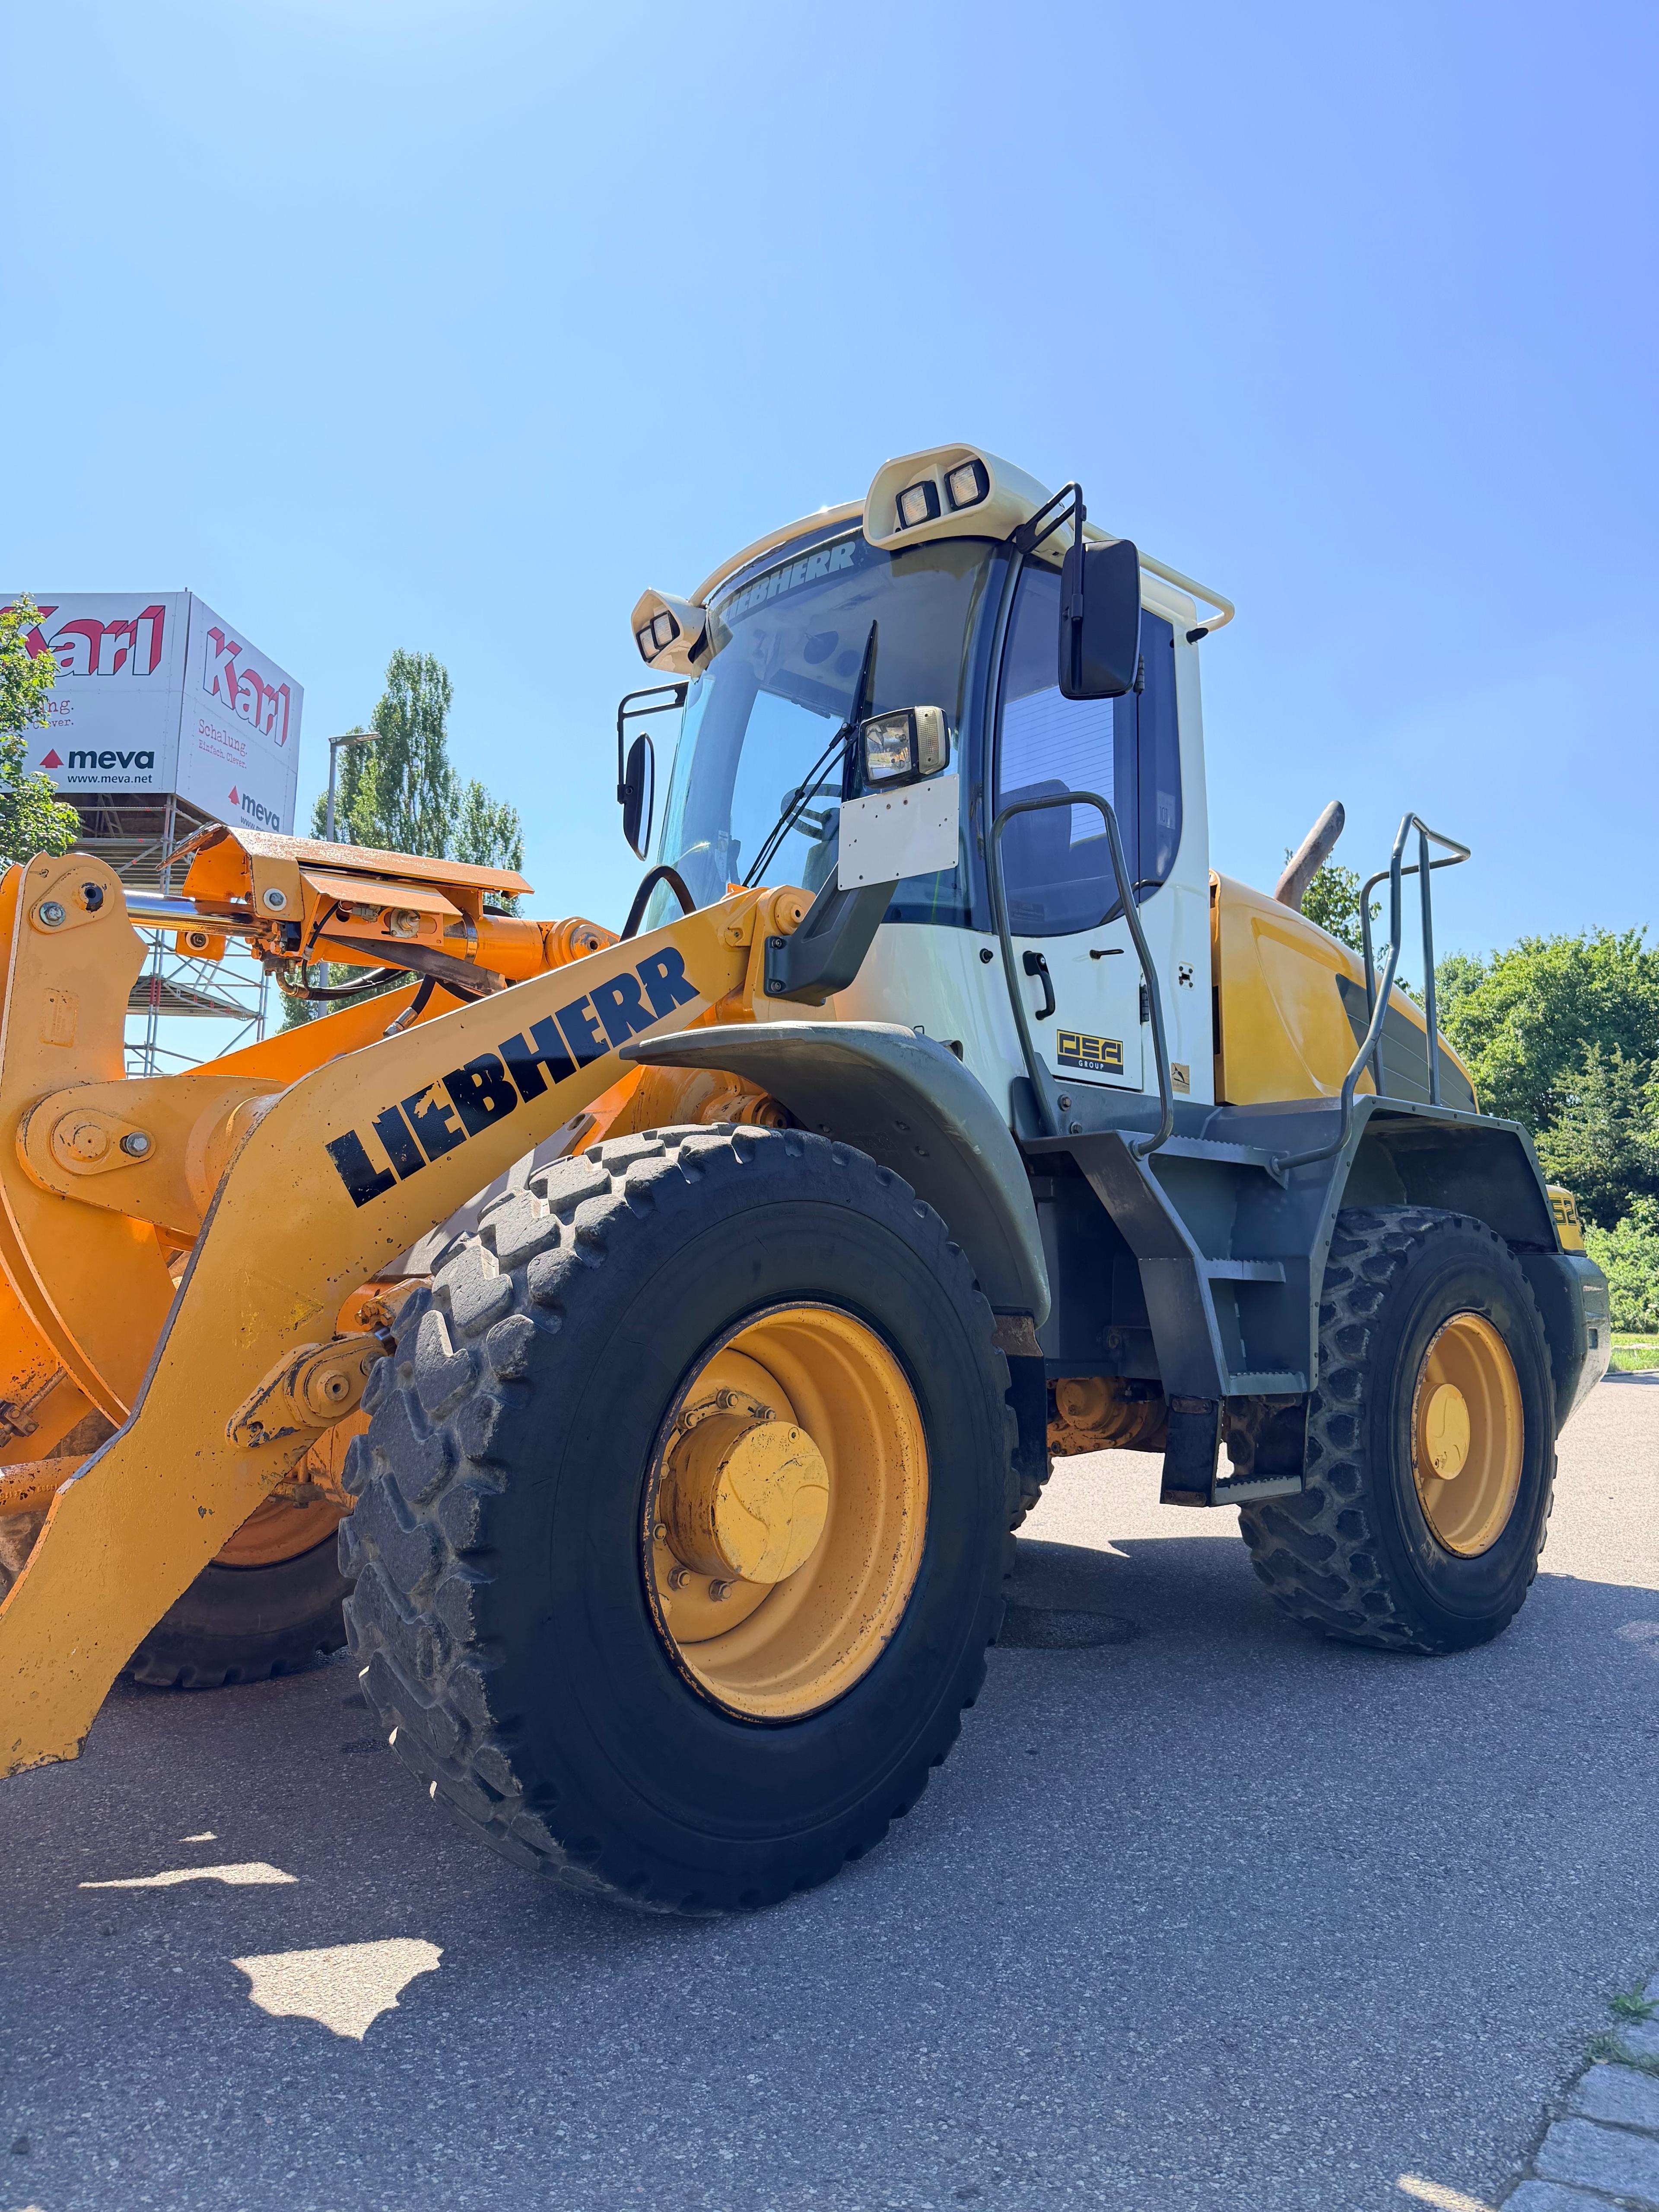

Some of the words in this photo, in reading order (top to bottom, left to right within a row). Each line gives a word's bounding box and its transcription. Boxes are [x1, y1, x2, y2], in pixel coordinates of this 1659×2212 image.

[203, 626, 290, 747] Karl
[199, 719, 248, 757] Schalung.
[68, 750, 155, 769] meva
[226, 752, 247, 769] Clever.
[67, 774, 153, 784] www.meva.net
[242, 793, 280, 833] meva
[324, 946, 700, 1208] LIEBHERR
[1078, 1060, 1104, 1070] GROUP
